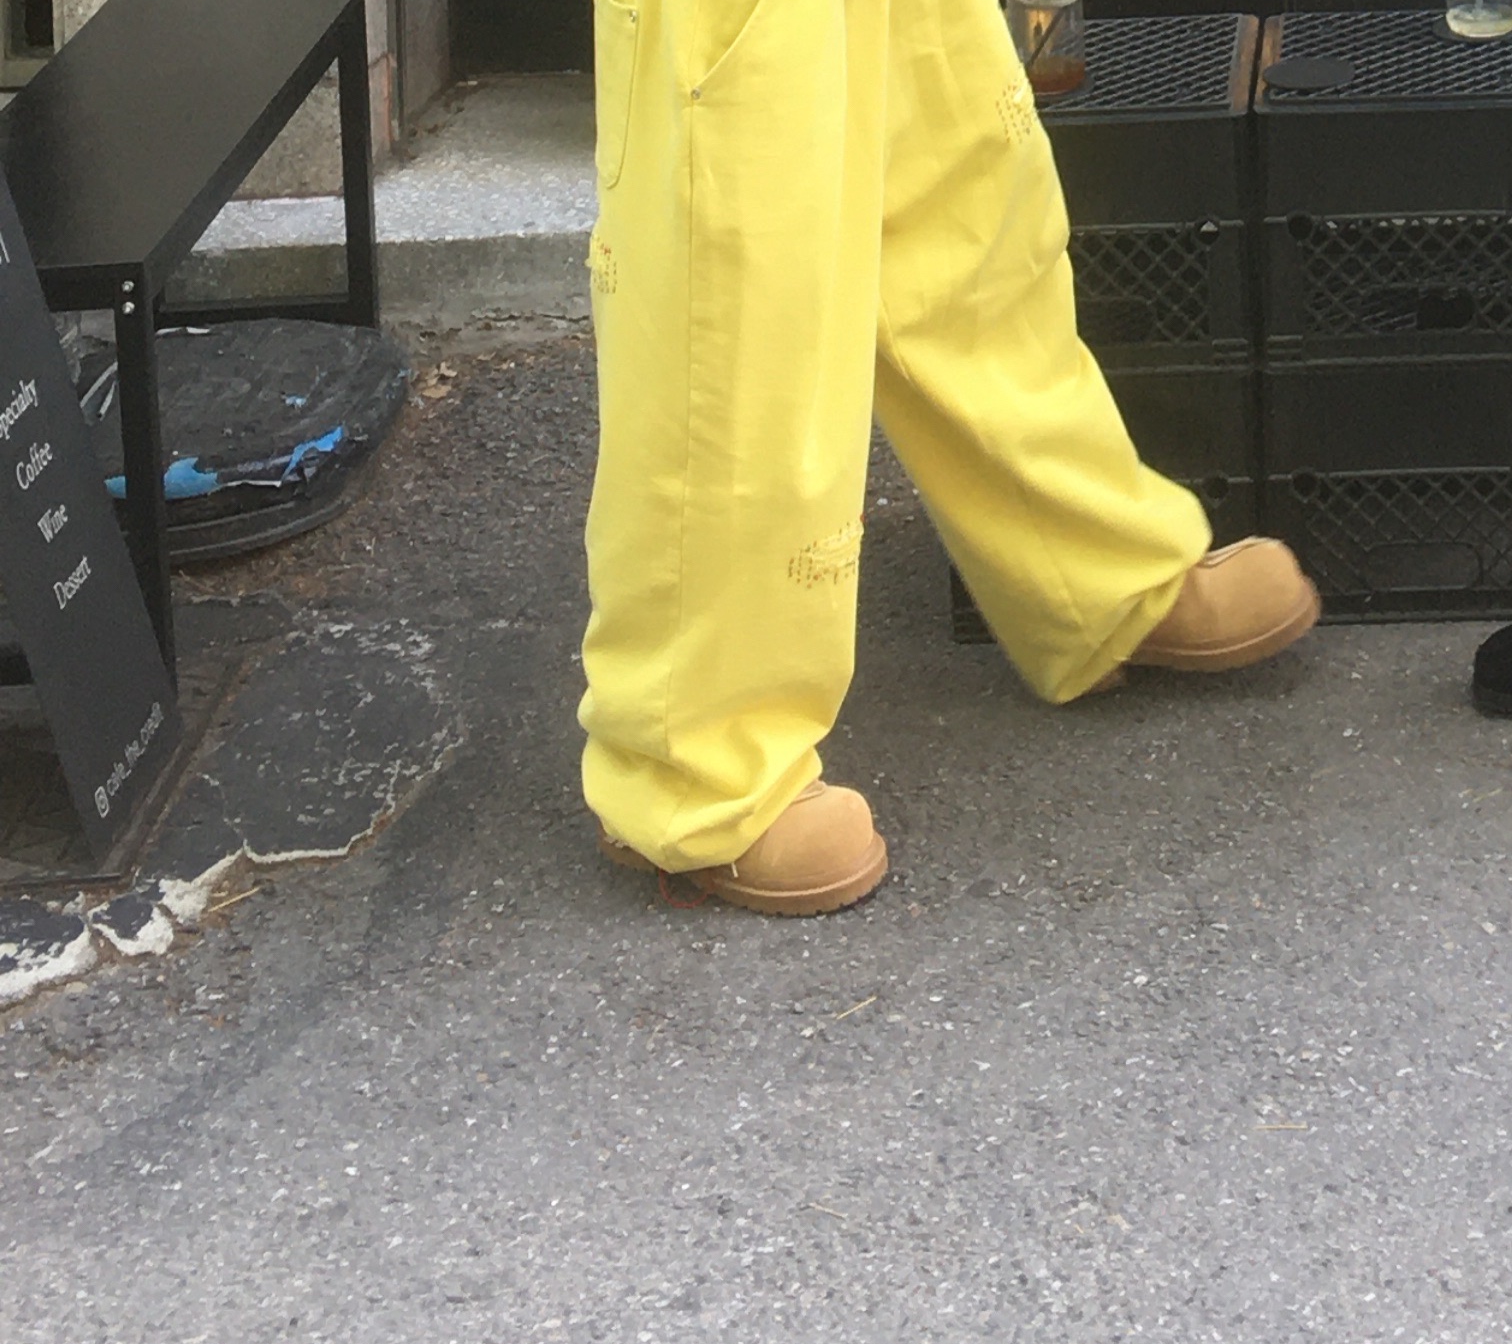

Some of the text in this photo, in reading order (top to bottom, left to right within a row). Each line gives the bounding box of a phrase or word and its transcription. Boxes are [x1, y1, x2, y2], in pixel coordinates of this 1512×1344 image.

[0, 378, 39, 440] pecialty
[16, 442, 53, 490] Coffee
[37, 504, 68, 543] Wine
[53, 555, 92, 610] Dessert
